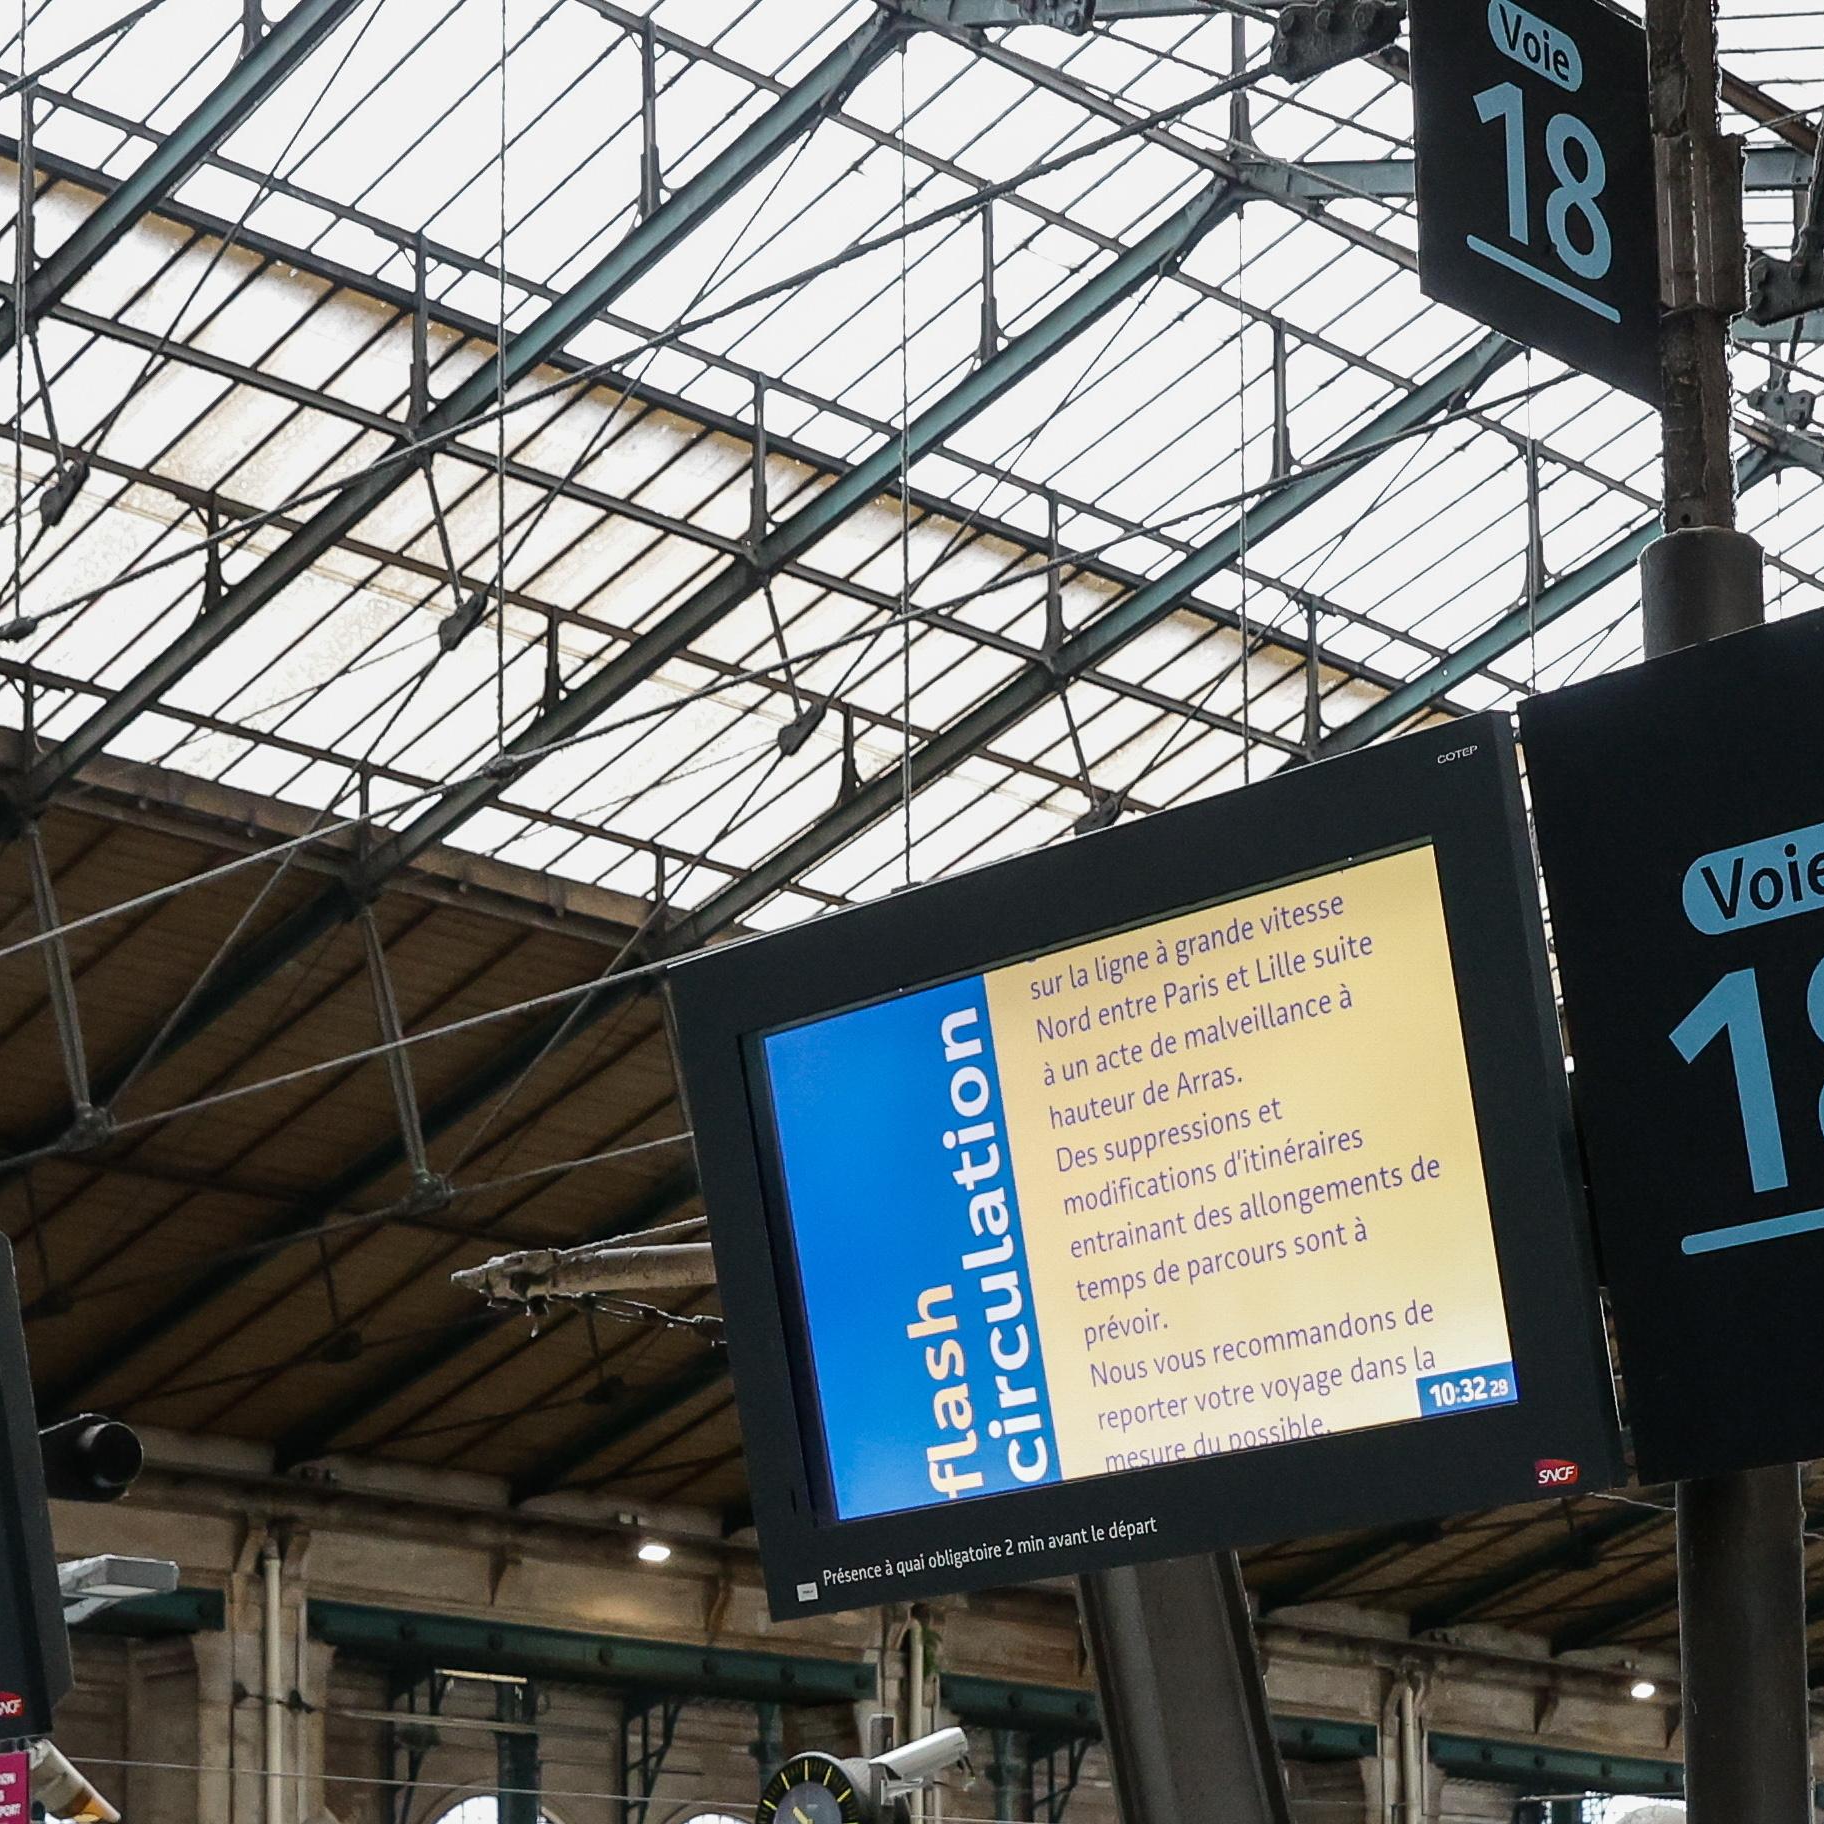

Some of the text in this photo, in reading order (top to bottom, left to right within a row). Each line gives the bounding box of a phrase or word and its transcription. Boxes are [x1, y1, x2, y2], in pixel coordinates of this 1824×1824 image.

[1499, 3, 1570, 82] Voie
[1473, 81, 1611, 280] 18
[1437, 745, 1478, 764] COTEP
[1030, 895, 1345, 1001] sur la ligne à grande vitesse
[1036, 935, 1374, 1044] Nord entre Paris et Lille suite
[1044, 983, 1353, 1087] à un acte de malveillance à
[1049, 1066, 1243, 1130] hauteur de Arras.
[1056, 1097, 1284, 1173] Des suppressions et
[1063, 1129, 1364, 1216] modifications d'itinéraires
[1070, 1154, 1441, 1259] entrainant des allongements de
[941, 1008, 1048, 1482] circulation
[1075, 1216, 1368, 1302] temps de parcours sont à
[1084, 1307, 1169, 1352] prévoir.
[1090, 1299, 1435, 1389] Nous vous recommandons de
[907, 1285, 983, 1499] flash
[1098, 1345, 1436, 1434] reporter votre voyage dans la
[1430, 1376, 1489, 1407] 10:32
[1105, 1413, 1332, 1474] mesure du possible.
[1538, 1465, 1575, 1484] SNCF
[823, 1516, 1158, 1587] Présence à quai obligatoire 2 min avant le départ
